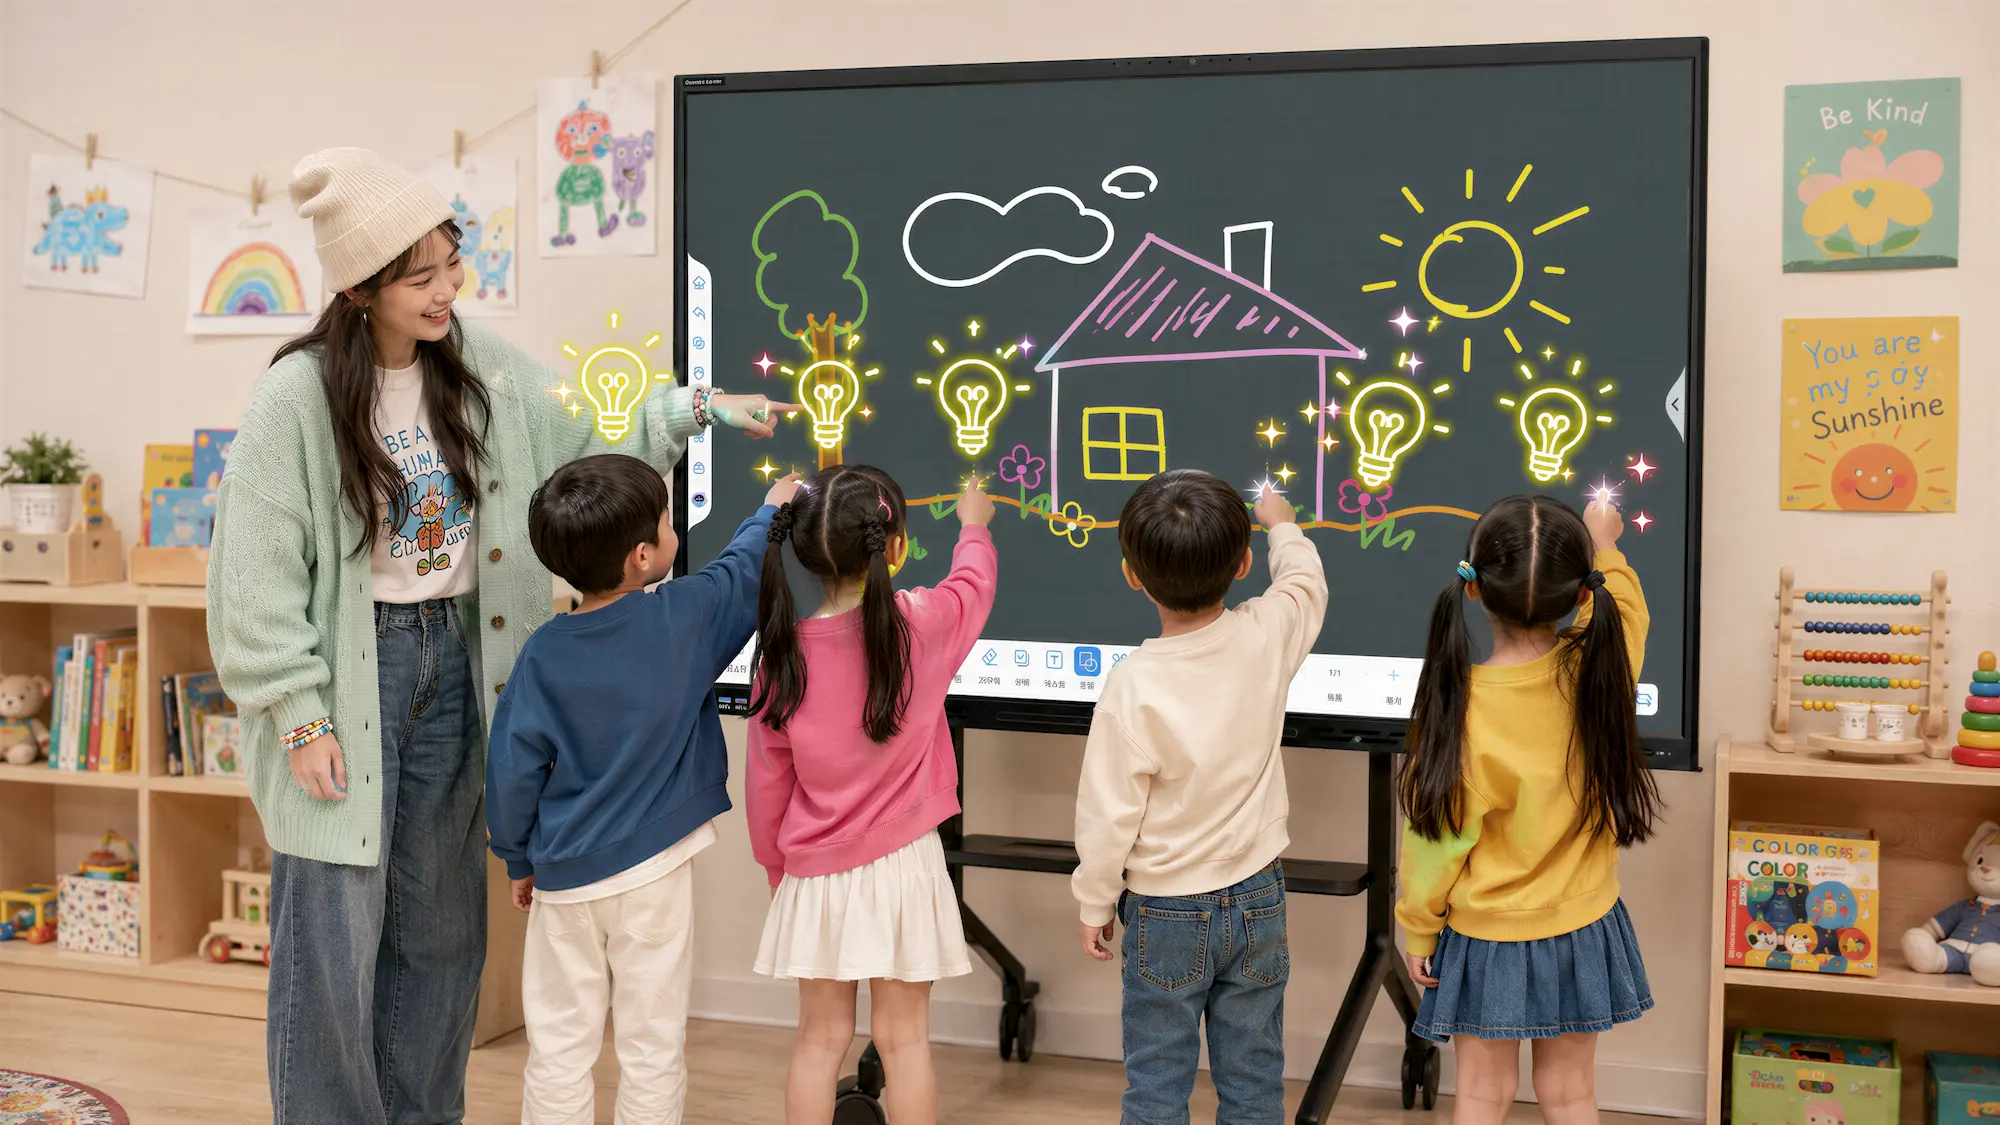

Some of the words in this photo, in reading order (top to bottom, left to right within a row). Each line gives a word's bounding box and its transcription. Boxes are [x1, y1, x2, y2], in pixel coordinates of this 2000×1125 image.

[1820, 106, 1853, 130] Be
[1867, 97, 1929, 126] Kind
[1802, 338, 1859, 369] You
[1873, 335, 1921, 356] are
[1808, 376, 1850, 405] my
[1811, 396, 1945, 440] Sunshine
[383, 429, 411, 455] BE
[415, 425, 429, 445] A
[1752, 839, 1819, 857] COLOR
[1747, 860, 1809, 878] COLOR
